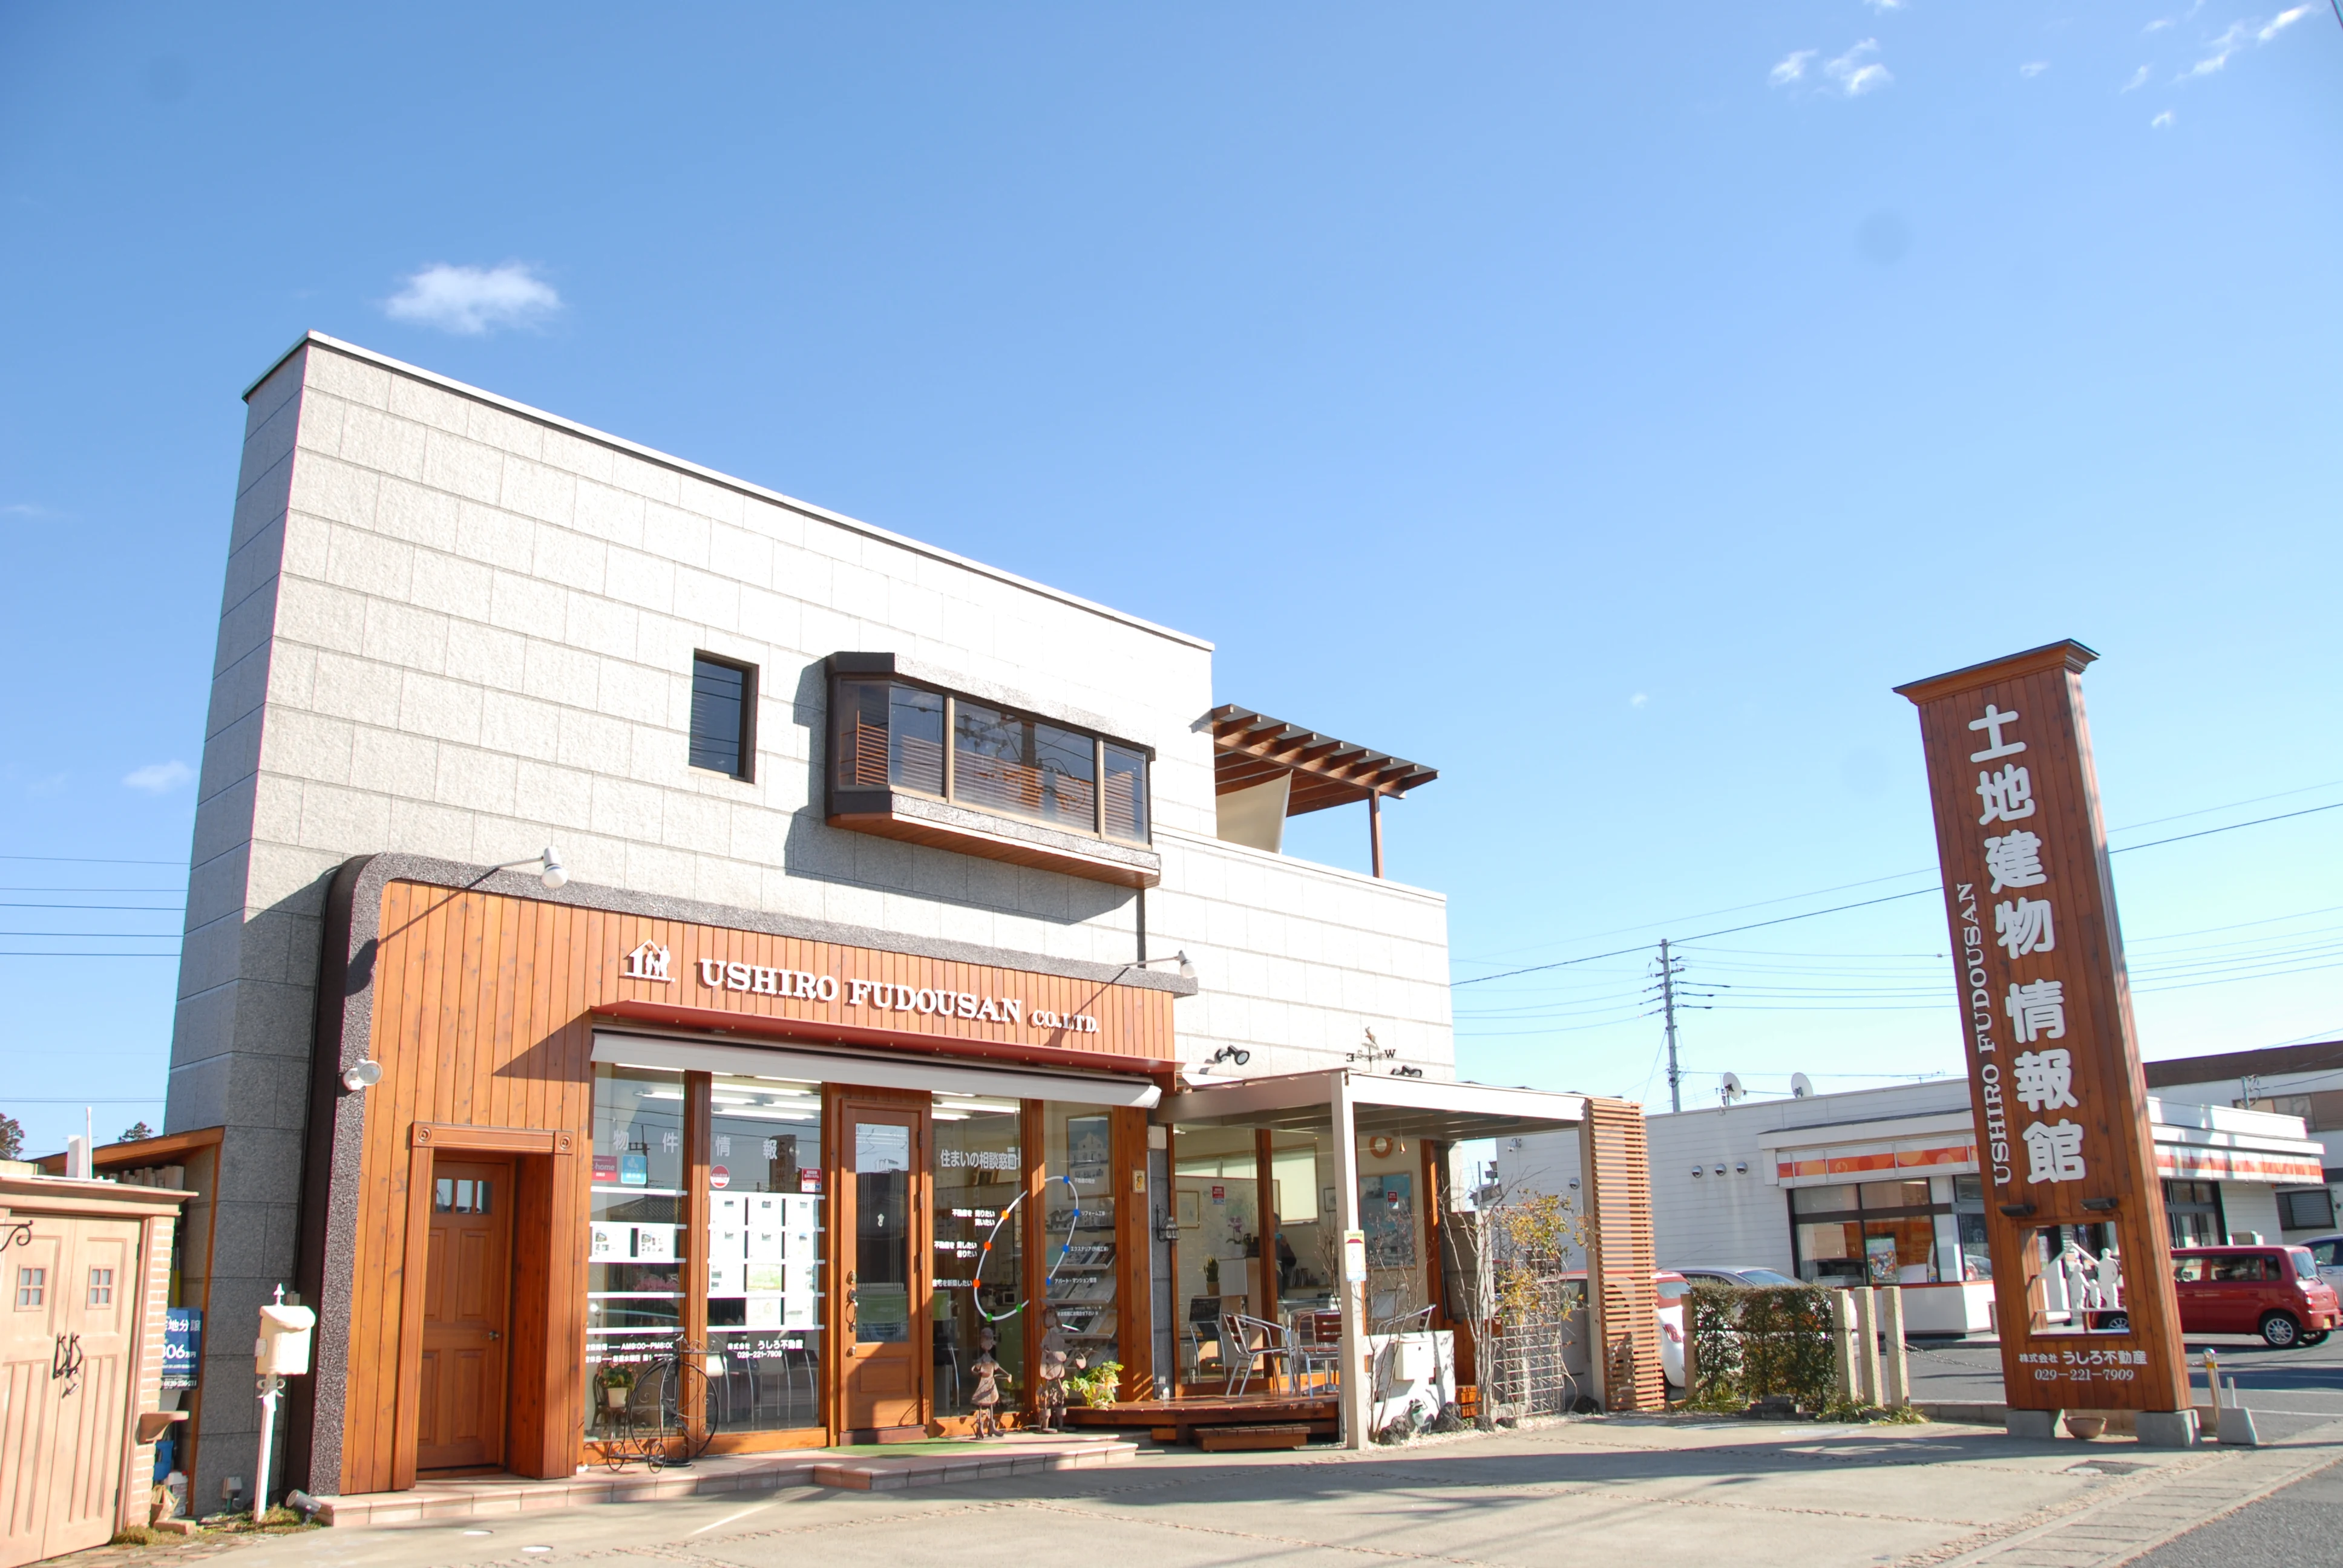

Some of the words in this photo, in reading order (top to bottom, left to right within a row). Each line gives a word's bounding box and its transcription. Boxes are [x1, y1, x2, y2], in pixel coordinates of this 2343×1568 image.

[1968, 704, 2086, 1184] 土地建物情報館
[1958, 883, 1996, 1053] FUDOUSAN
[700, 958, 839, 1001] USHIRO
[849, 978, 1021, 1023] FUDOUSAN
[1982, 1064, 2011, 1186] USHIRO
[940, 1149, 1017, 1170] 住まいの相談窓口
[737, 1350, 782, 1359] 029-221-7909
[758, 1339, 803, 1349] うしろ不動産
[2019, 1353, 2058, 1363] 株式会社
[2063, 1350, 2147, 1365] うしろ不動産
[2034, 1369, 2134, 1380] 029-221-7909
